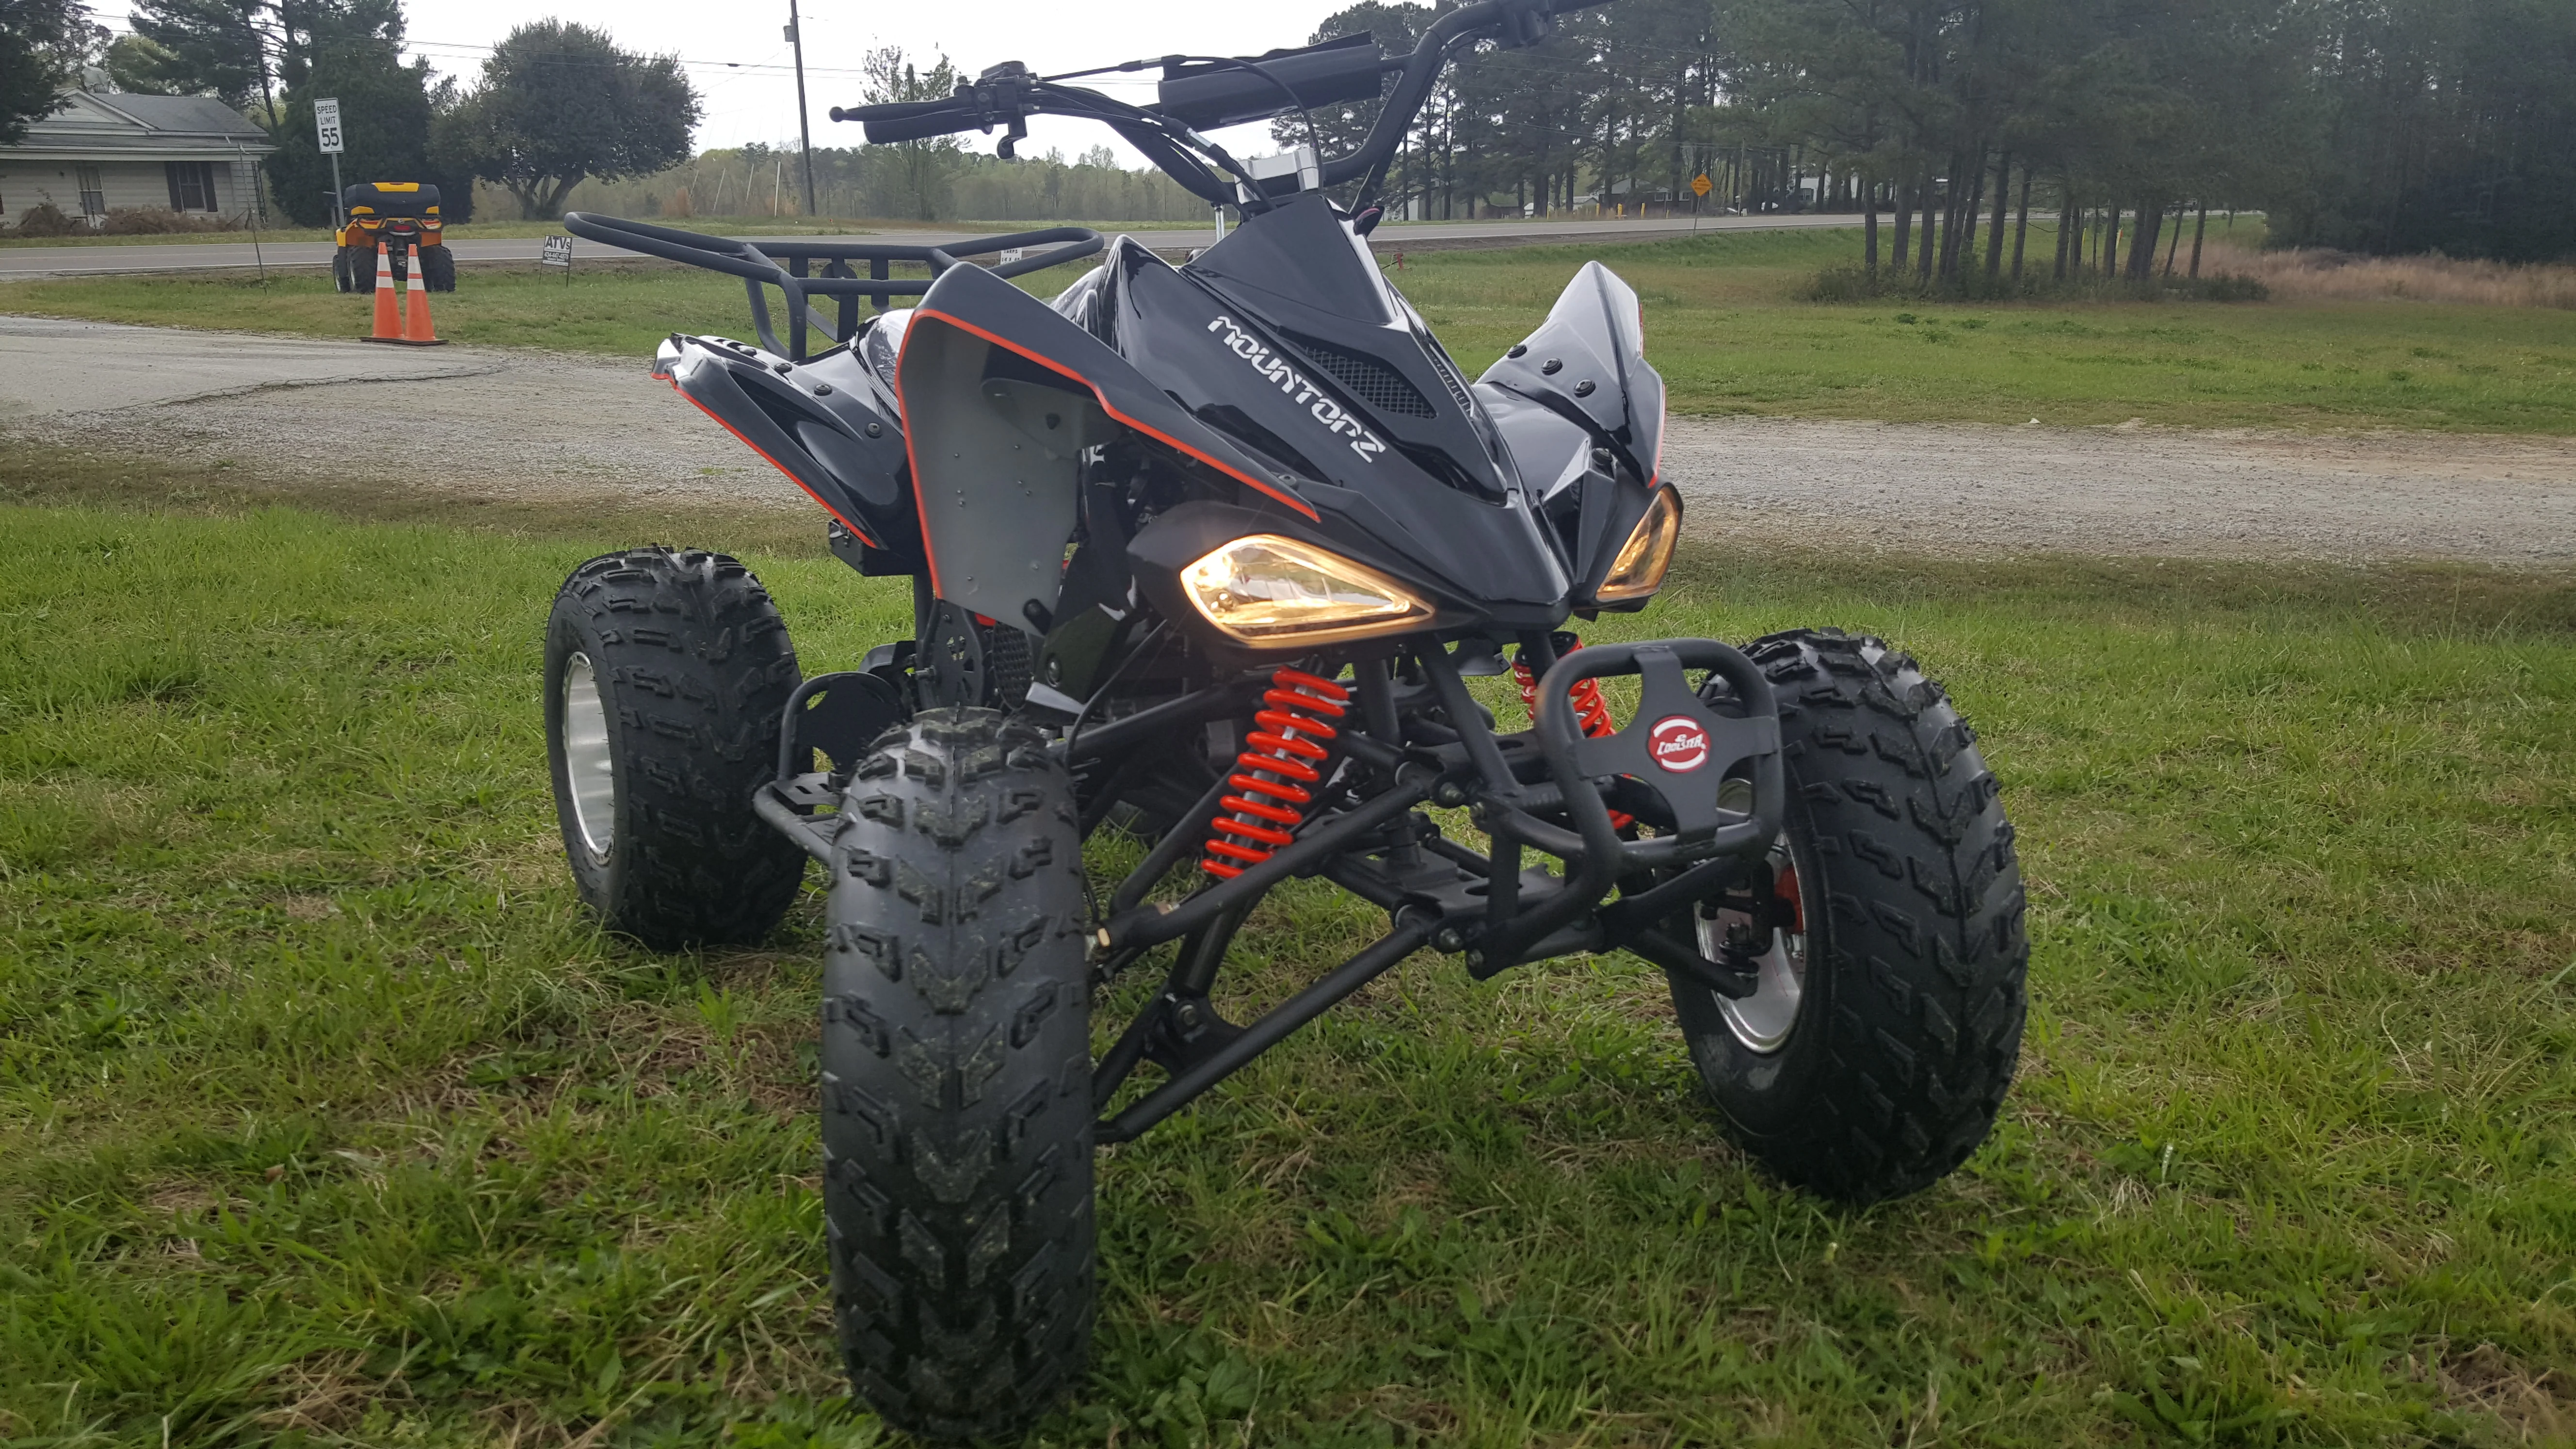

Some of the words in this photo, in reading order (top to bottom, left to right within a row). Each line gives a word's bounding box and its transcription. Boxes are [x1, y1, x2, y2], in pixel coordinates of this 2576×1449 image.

[317, 105, 337, 114] SPEED
[320, 116, 336, 125] LIMIT
[322, 127, 339, 147] 55
[545, 236, 570, 250] ATVs
[1207, 315, 1386, 464] MOUNTOPZ
